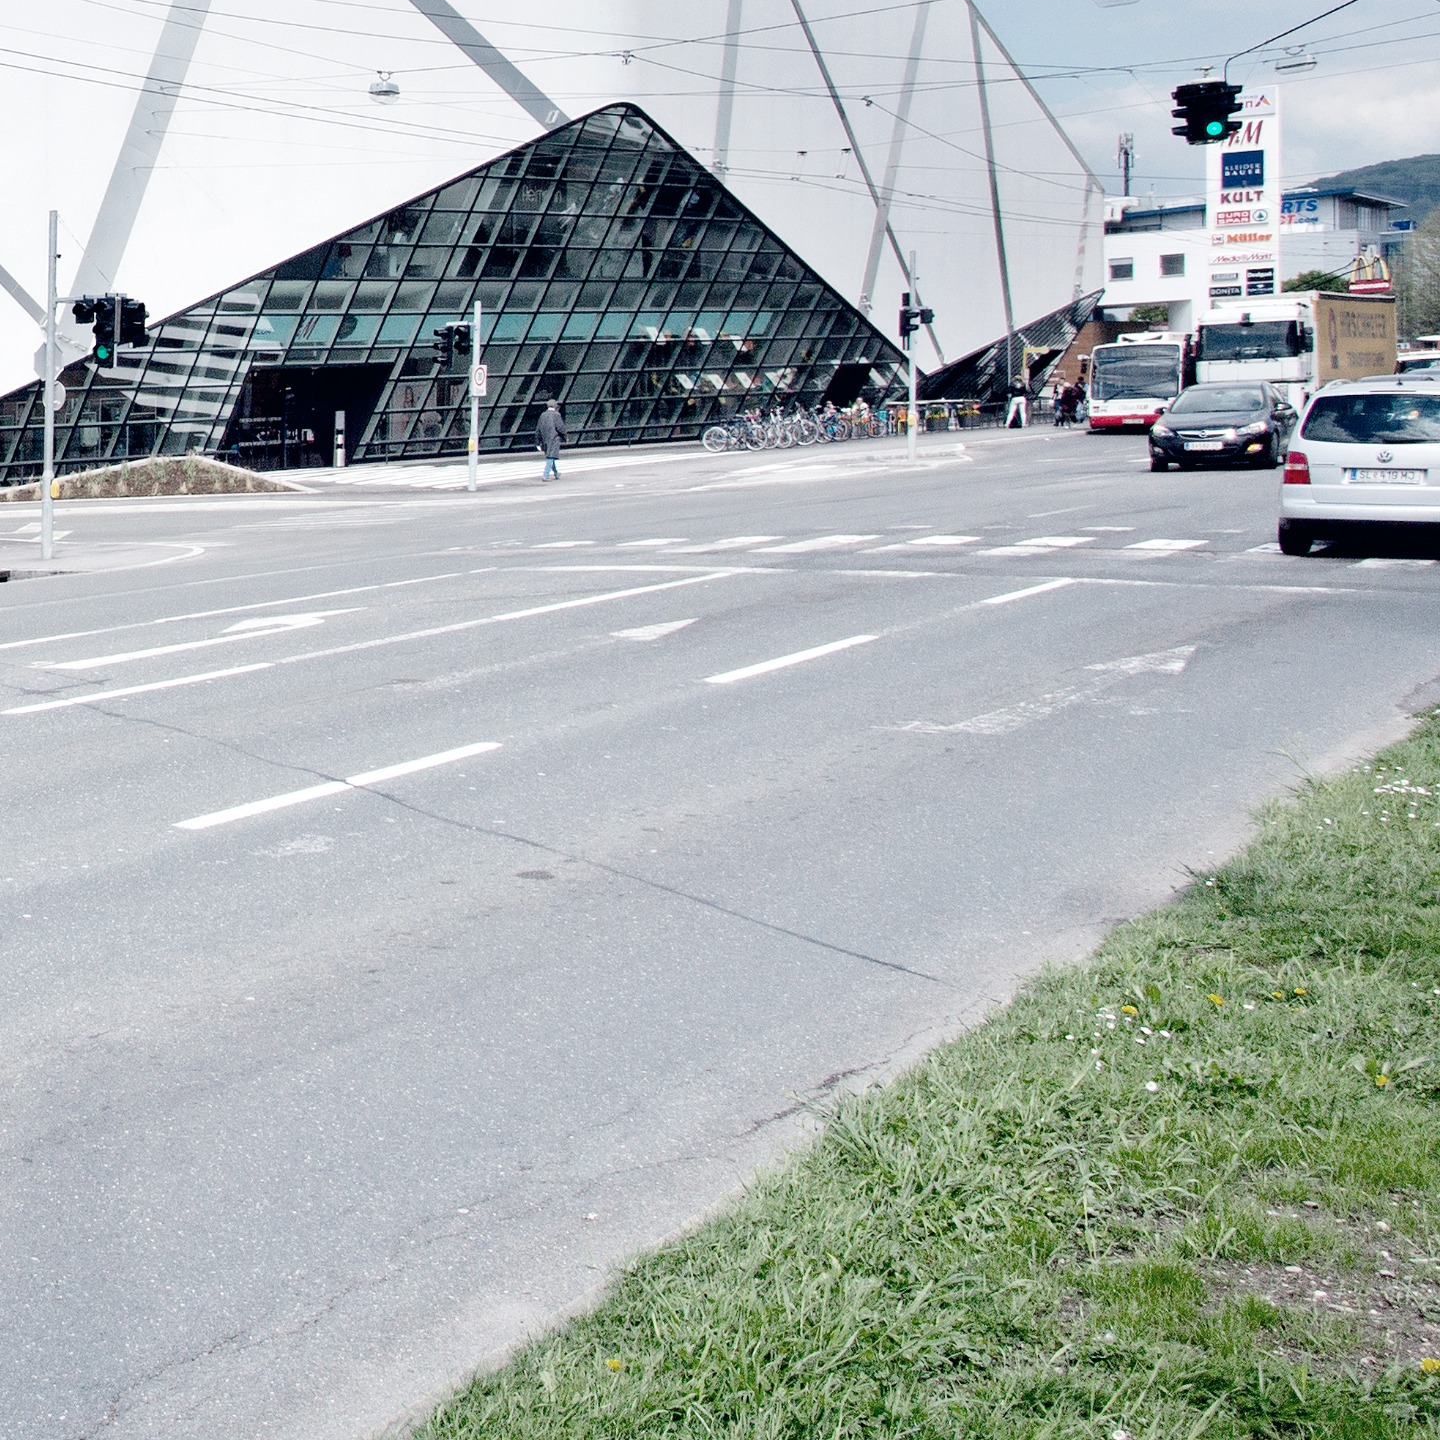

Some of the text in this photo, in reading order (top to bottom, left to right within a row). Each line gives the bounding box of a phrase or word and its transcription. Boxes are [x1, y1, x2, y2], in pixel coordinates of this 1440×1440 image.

[1220, 190, 1264, 204] KULT
[1226, 233, 1272, 243] Müller
[1359, 470, 1371, 479] SL
